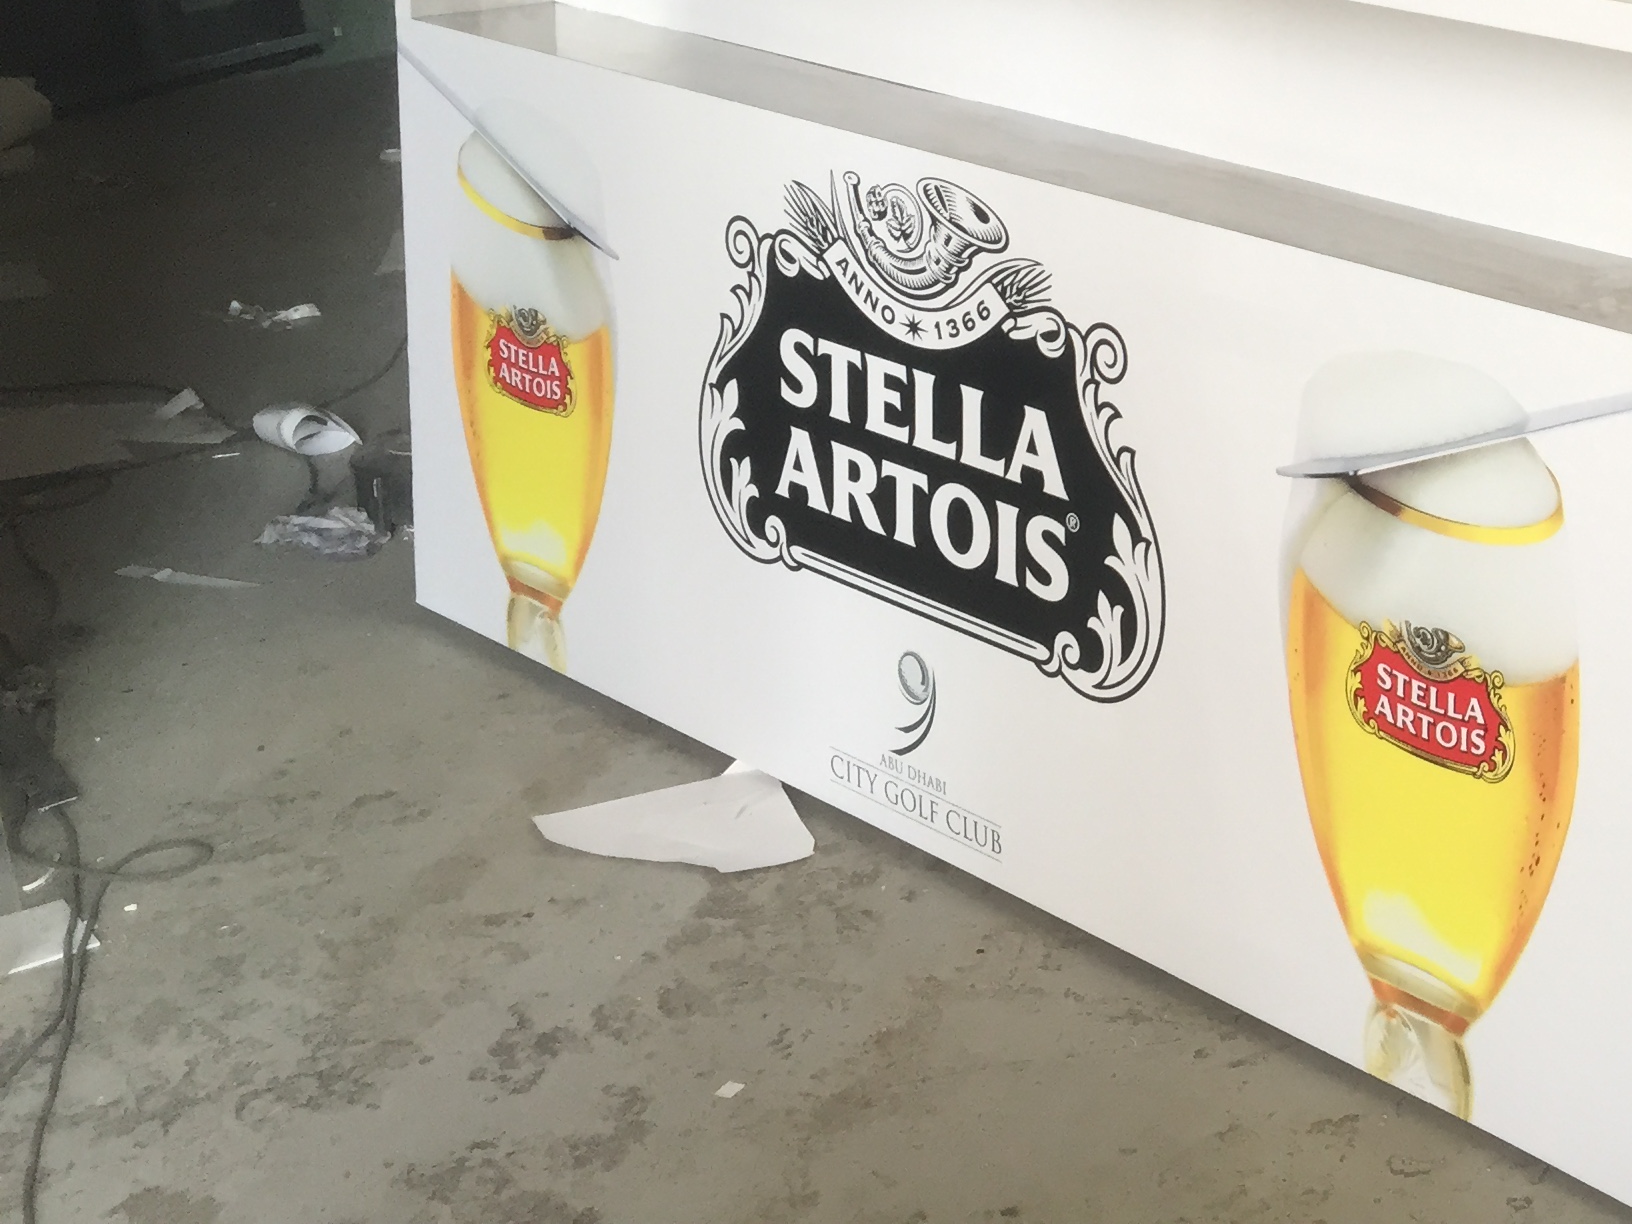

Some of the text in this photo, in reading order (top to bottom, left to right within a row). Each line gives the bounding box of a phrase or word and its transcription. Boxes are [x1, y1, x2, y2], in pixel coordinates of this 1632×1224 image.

[834, 256, 992, 340] ANNO 1366
[499, 338, 560, 377] STELLA
[499, 362, 561, 400] ARTOIS
[779, 328, 1070, 501] STELLA
[775, 426, 1070, 602] ARTOIS
[1374, 694, 1486, 756] ARTOIS
[1376, 662, 1485, 725] STELLA
[830, 754, 1002, 855] CITY GOLF CLUB
[879, 753, 947, 796] ABU DHABI
